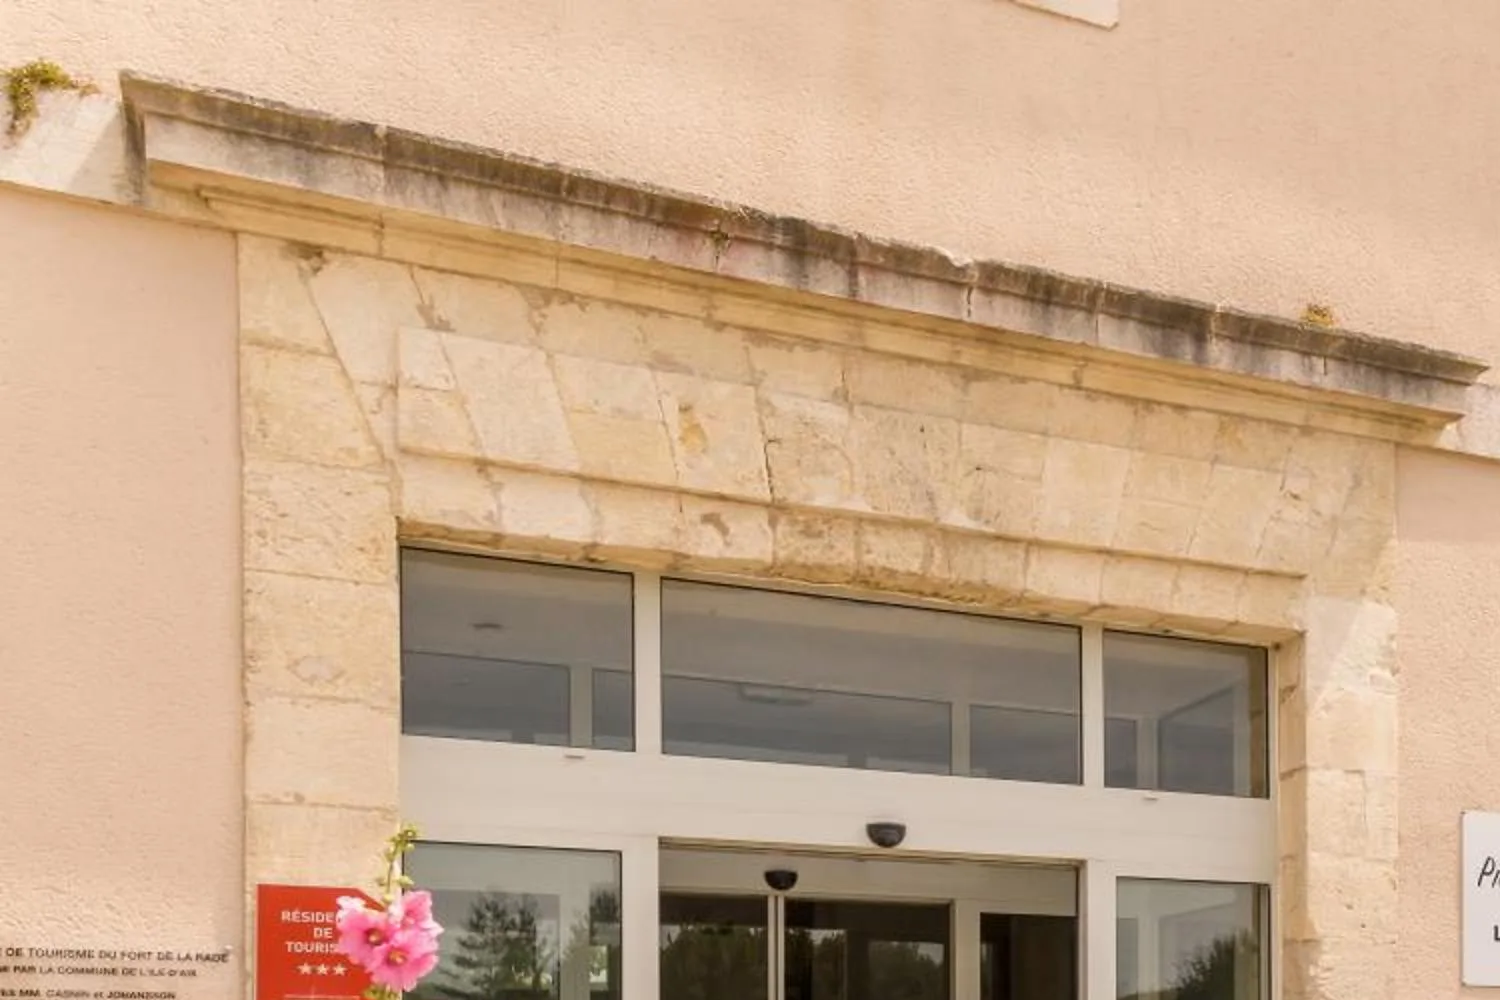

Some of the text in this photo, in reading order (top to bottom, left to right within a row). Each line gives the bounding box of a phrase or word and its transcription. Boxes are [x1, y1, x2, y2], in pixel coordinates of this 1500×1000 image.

[281, 908, 336, 924] RÉSIDE
[313, 927, 333, 939] DE
[285, 941, 339, 953] TOURIS
[6, 947, 23, 958] DE
[28, 947, 96, 960] TOURISME
[98, 949, 118, 960] DU
[120, 950, 153, 961] FORT
[157, 951, 174, 962] DE
[177, 952, 194, 962] LA
[195, 953, 229, 963] RADE
[13, 965, 37, 974] PAR
[39, 966, 55, 975] LA
[57, 966, 118, 976] COMMUNE
